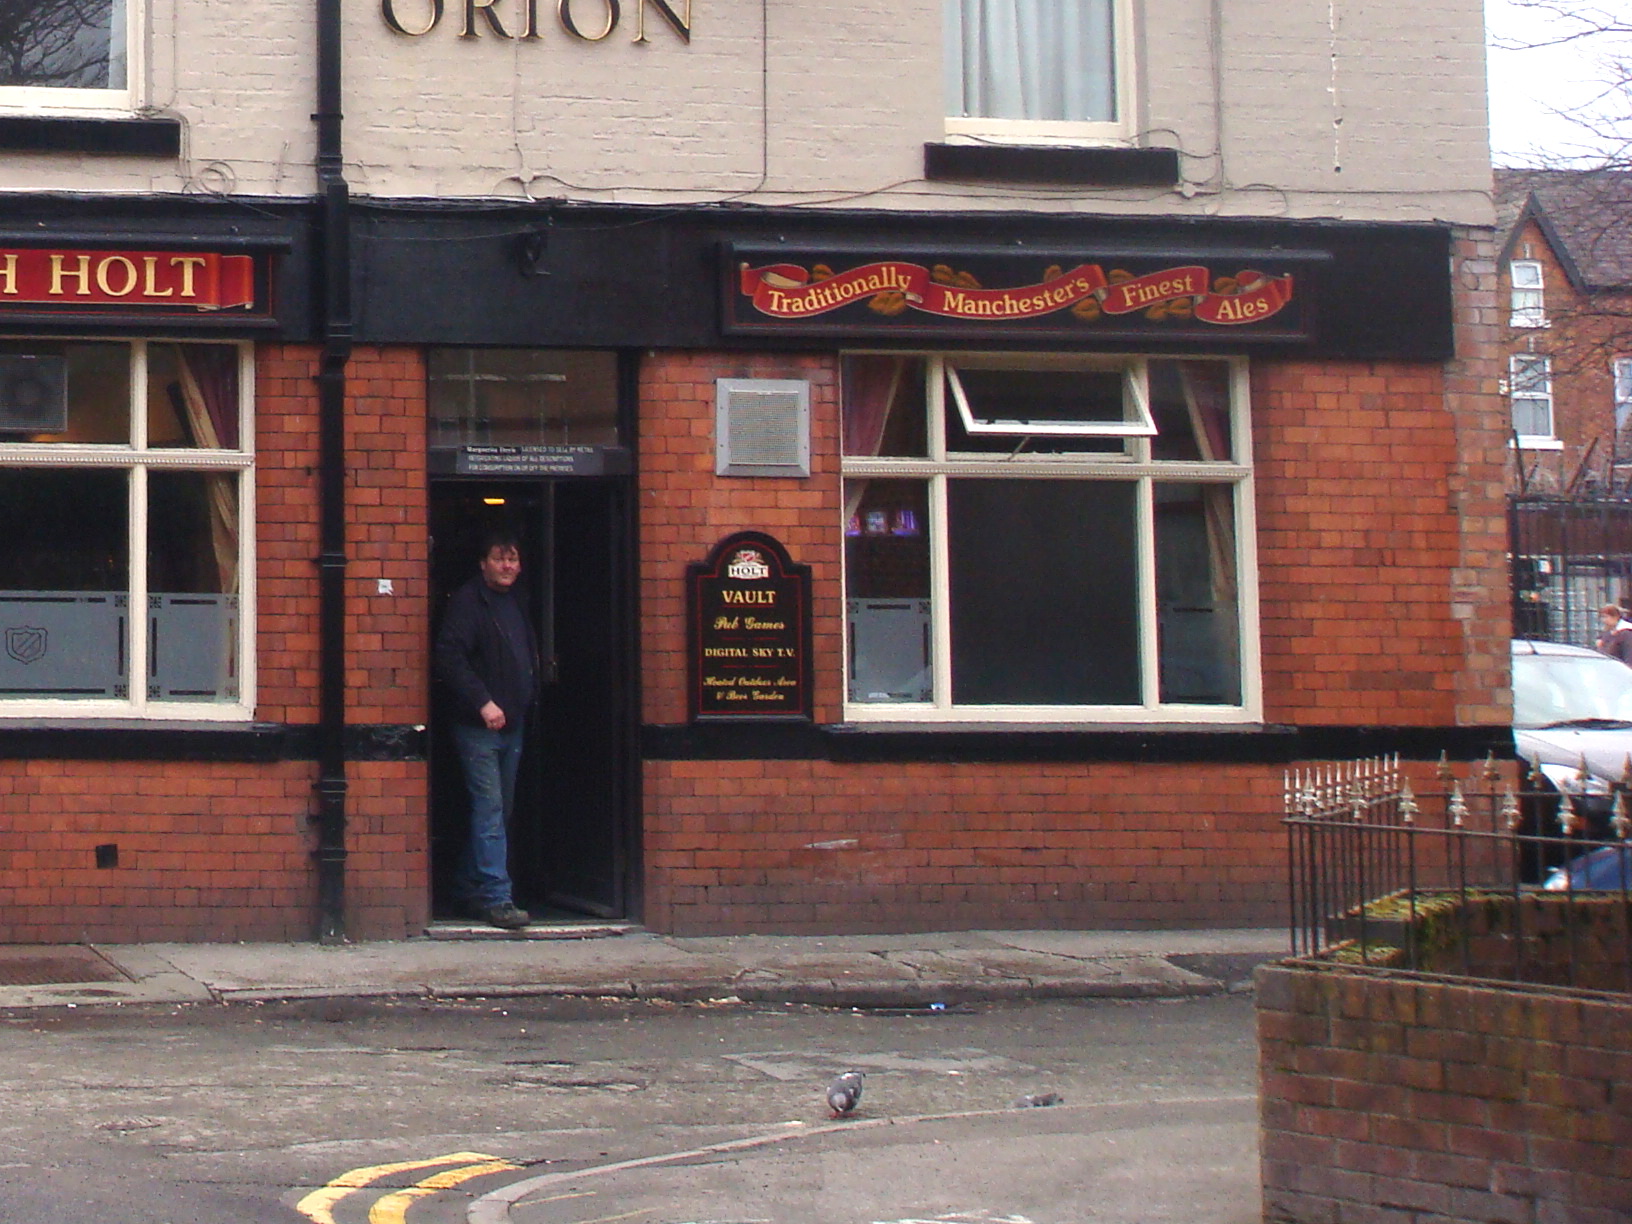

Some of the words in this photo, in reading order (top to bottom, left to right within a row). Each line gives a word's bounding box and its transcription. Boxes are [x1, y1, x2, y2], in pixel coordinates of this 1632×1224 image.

[49, 254, 206, 297] HOLT
[768, 266, 912, 313] Traditionally
[943, 276, 1090, 315] Manchester's
[1121, 274, 1195, 307] Finest
[1216, 297, 1269, 320] Ales
[730, 567, 766, 576] HOLT
[722, 590, 776, 604] VAULT
[713, 616, 739, 630] Pub
[744, 616, 785, 630] Games
[704, 648, 748, 657] DIGITAL
[752, 648, 774, 657] SKY
[776, 648, 796, 657] T.V.
[752, 690, 785, 701] Garden
